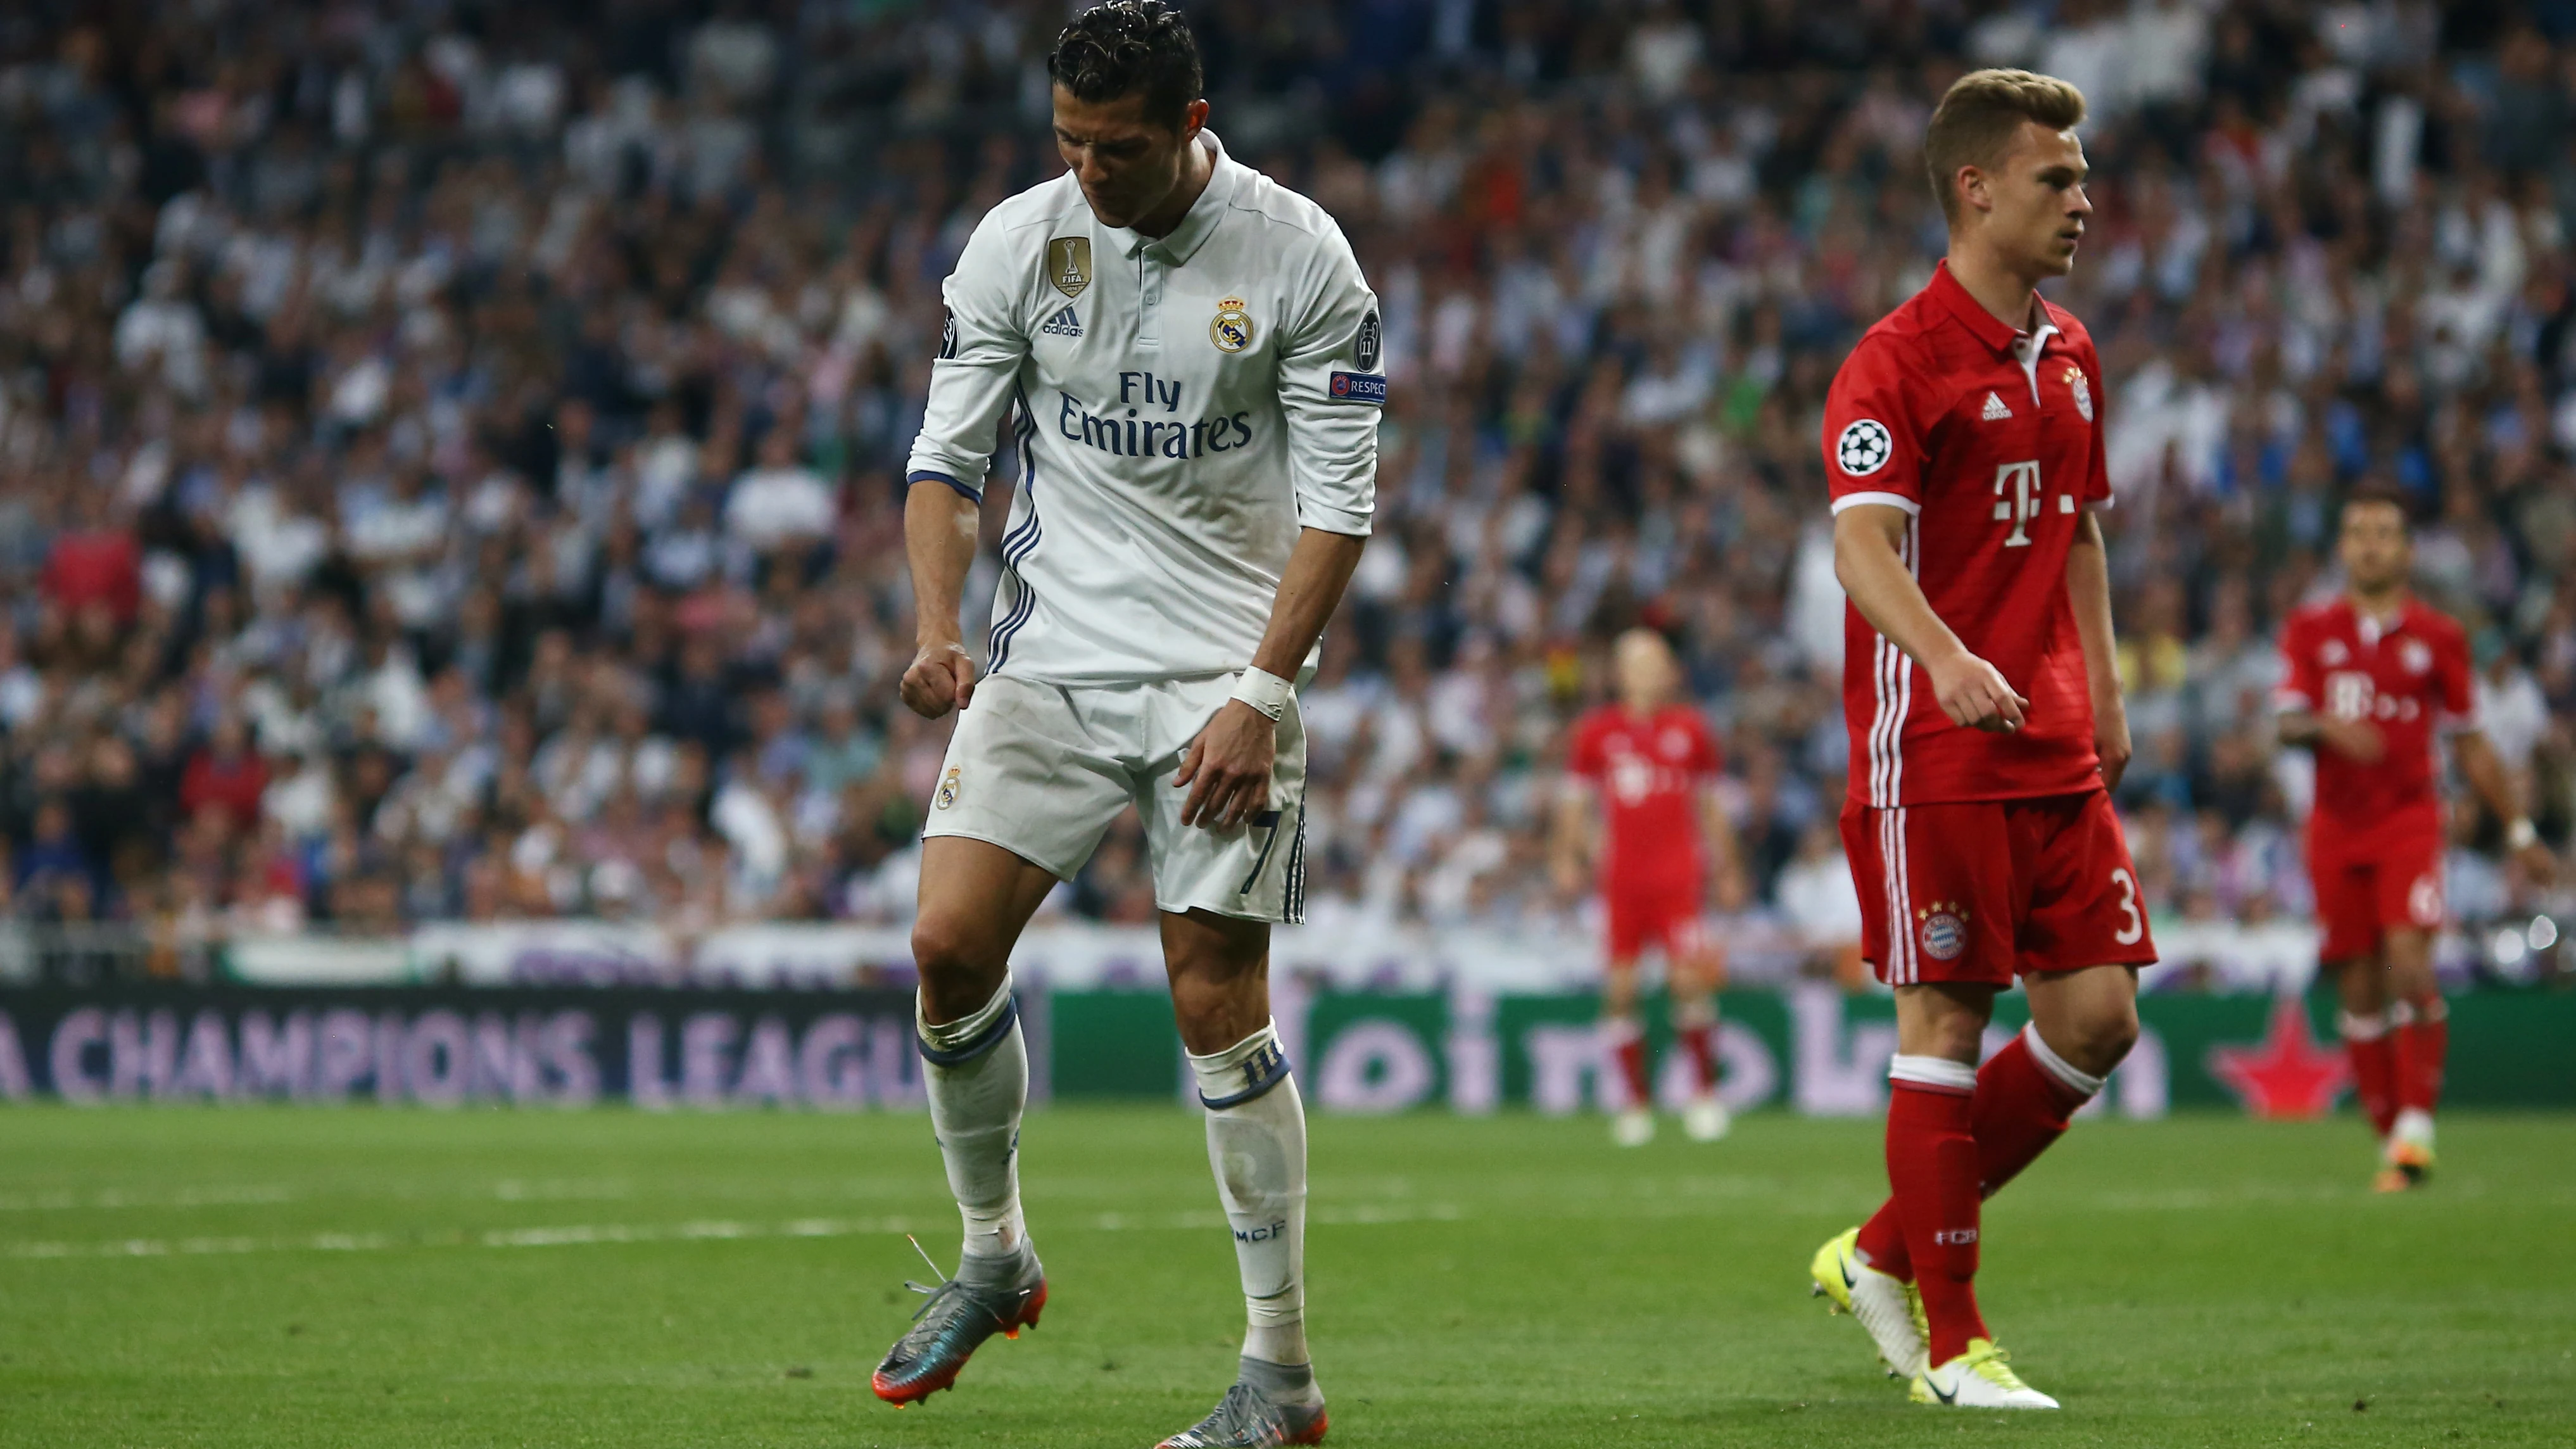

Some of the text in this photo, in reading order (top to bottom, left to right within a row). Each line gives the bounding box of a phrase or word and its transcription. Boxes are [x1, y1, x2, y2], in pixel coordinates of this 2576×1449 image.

[1062, 275, 1082, 283] FIFA
[1043, 324, 1083, 338] adidas
[1361, 341, 1372, 355] 11
[1119, 371, 1181, 412] Fly
[1351, 381, 1386, 395] RESPECT
[1059, 390, 1253, 459] Emirates
[1240, 810, 1282, 895] 7
[2111, 868, 2143, 946] 3
[49, 1008, 598, 1108] CHAMPIONS
[626, 1009, 932, 1110] LEAGU
